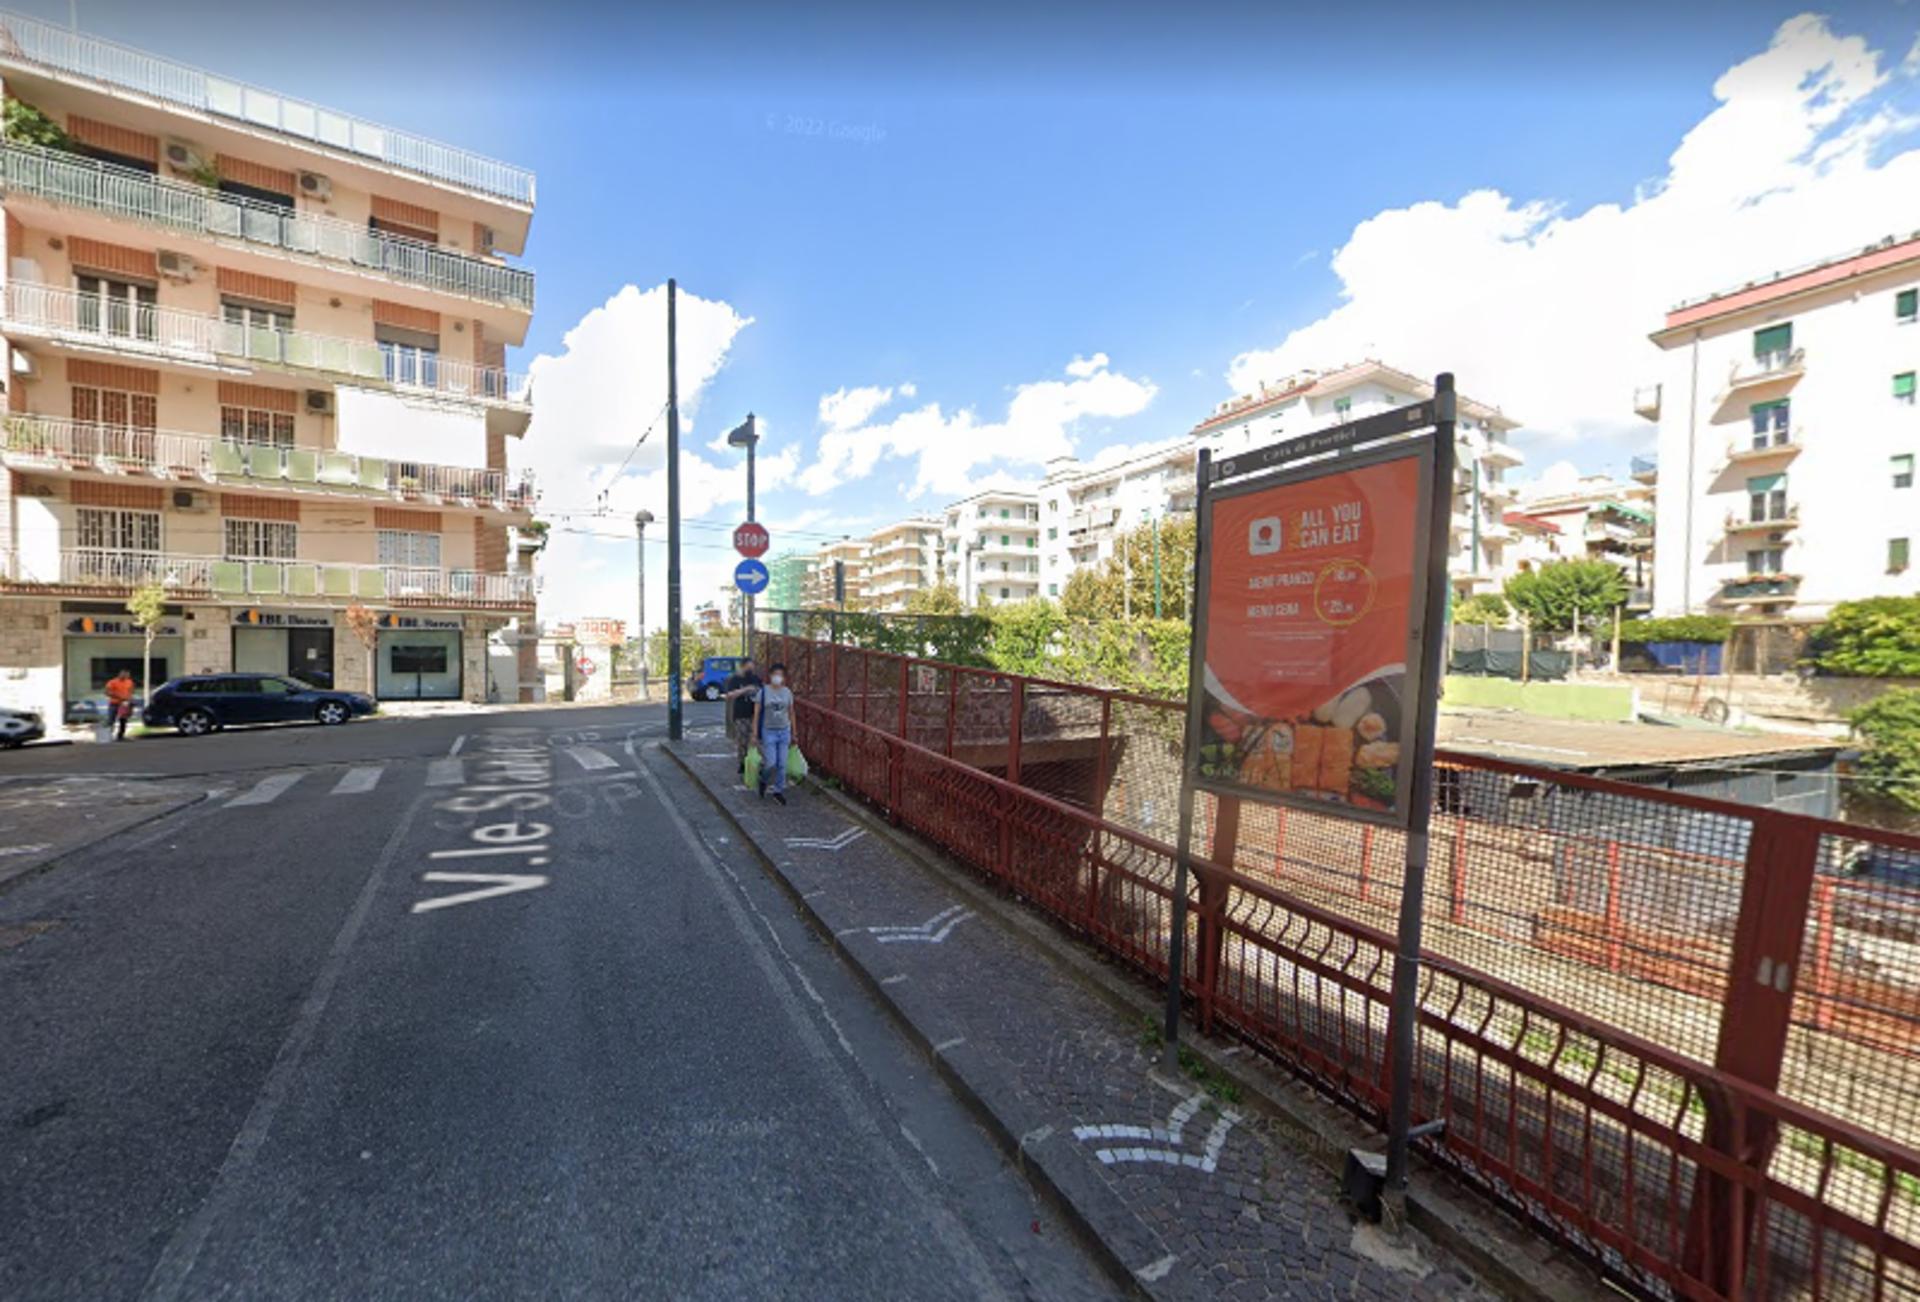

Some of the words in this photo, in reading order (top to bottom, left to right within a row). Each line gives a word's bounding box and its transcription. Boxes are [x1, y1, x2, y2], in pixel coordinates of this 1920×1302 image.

[1301, 508, 1326, 529] ALL
[1331, 500, 1361, 524] YOU
[736, 532, 768, 547] STOP
[1299, 527, 1329, 549] CAN
[1332, 522, 1361, 545] EAT
